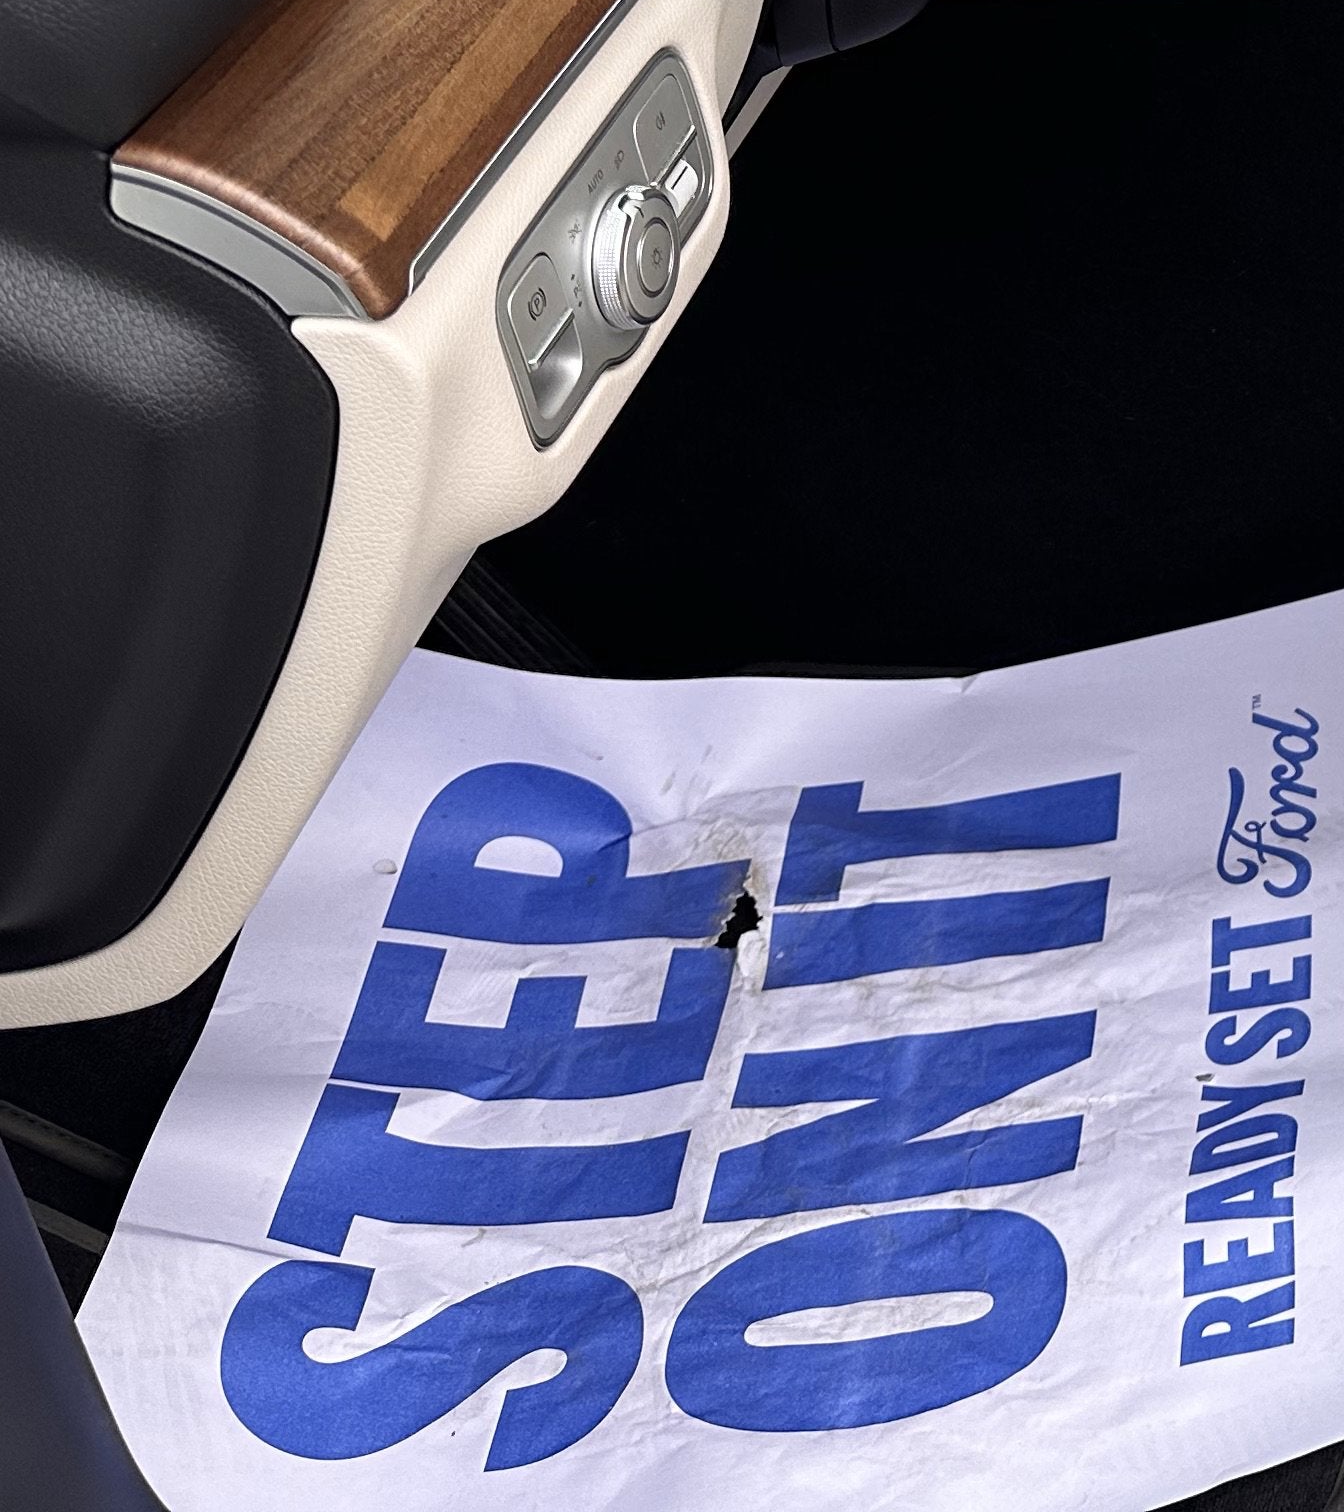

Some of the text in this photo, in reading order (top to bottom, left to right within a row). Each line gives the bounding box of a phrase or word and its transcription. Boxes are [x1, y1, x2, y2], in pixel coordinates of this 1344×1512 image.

[587, 169, 604, 194] AUTO
[1216, 707, 1321, 899] Ford
[664, 774, 1121, 1433] ON IT
[1204, 914, 1313, 1066] SET
[221, 763, 750, 1473] STEP
[1180, 1079, 1306, 1367] READY
